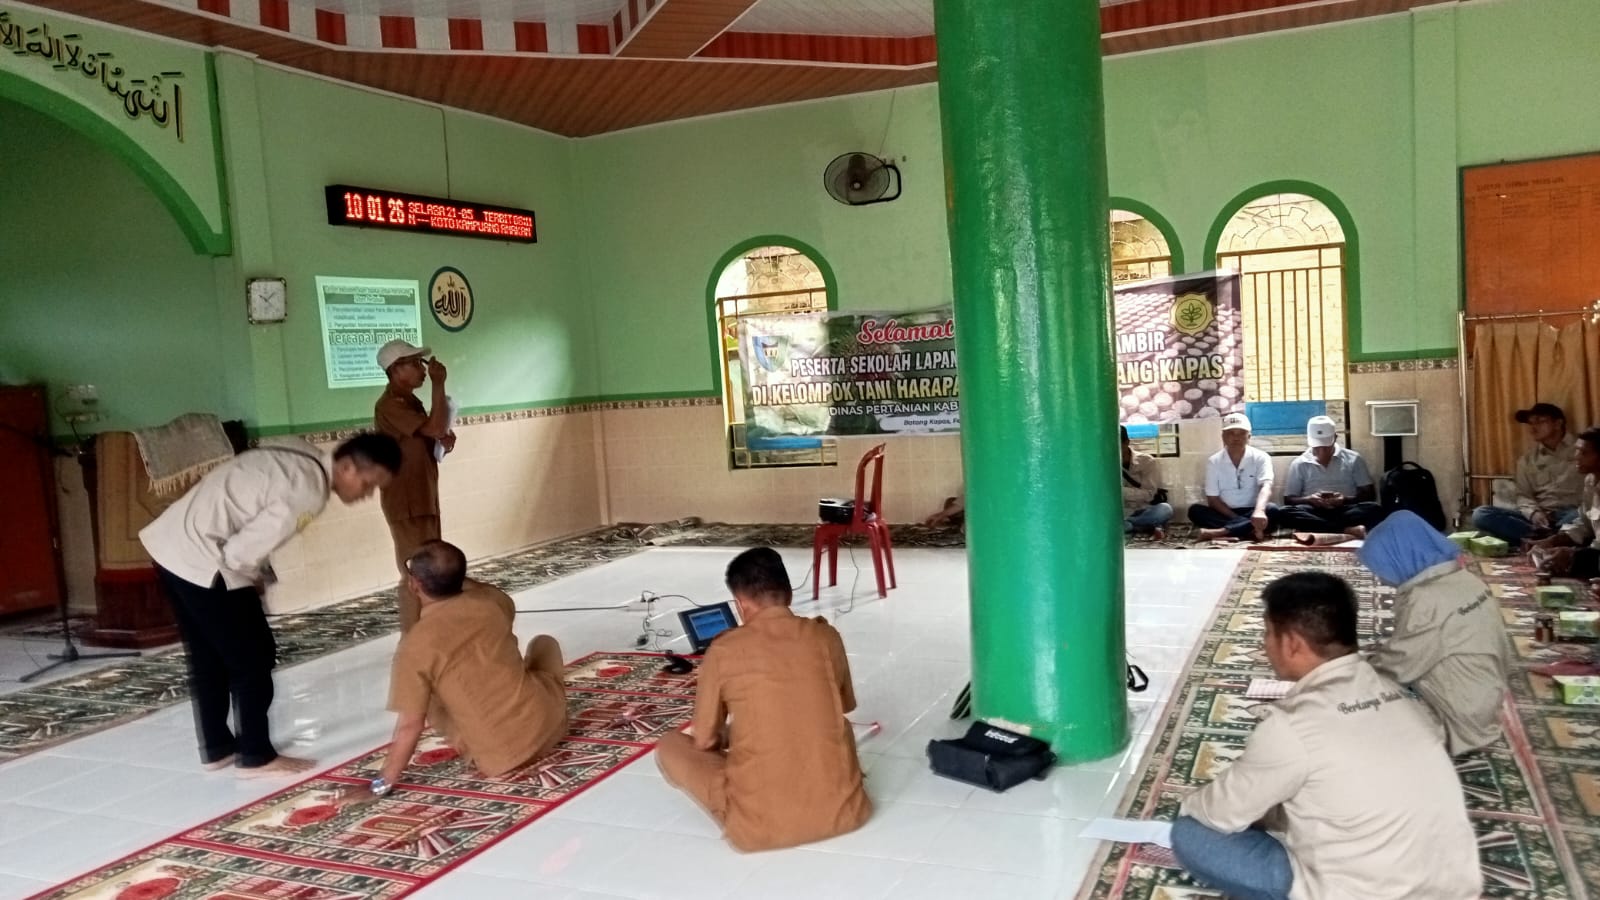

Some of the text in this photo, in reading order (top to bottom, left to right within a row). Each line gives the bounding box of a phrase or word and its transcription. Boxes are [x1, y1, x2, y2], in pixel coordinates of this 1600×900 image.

[344, 192, 405, 223] 10 01 26
[328, 330, 376, 346] Tercapai
[856, 319, 955, 344] Selamat
[791, 357, 846, 377] PESERTA
[850, 352, 911, 374] SEKOLAH
[752, 385, 768, 406] DI
[772, 381, 855, 405] KELOMPOK
[857, 380, 892, 401] TANI
[1159, 354, 1224, 382] KAPAS
[829, 406, 863, 416] DINAS
[866, 402, 930, 414] PERTANIAN
